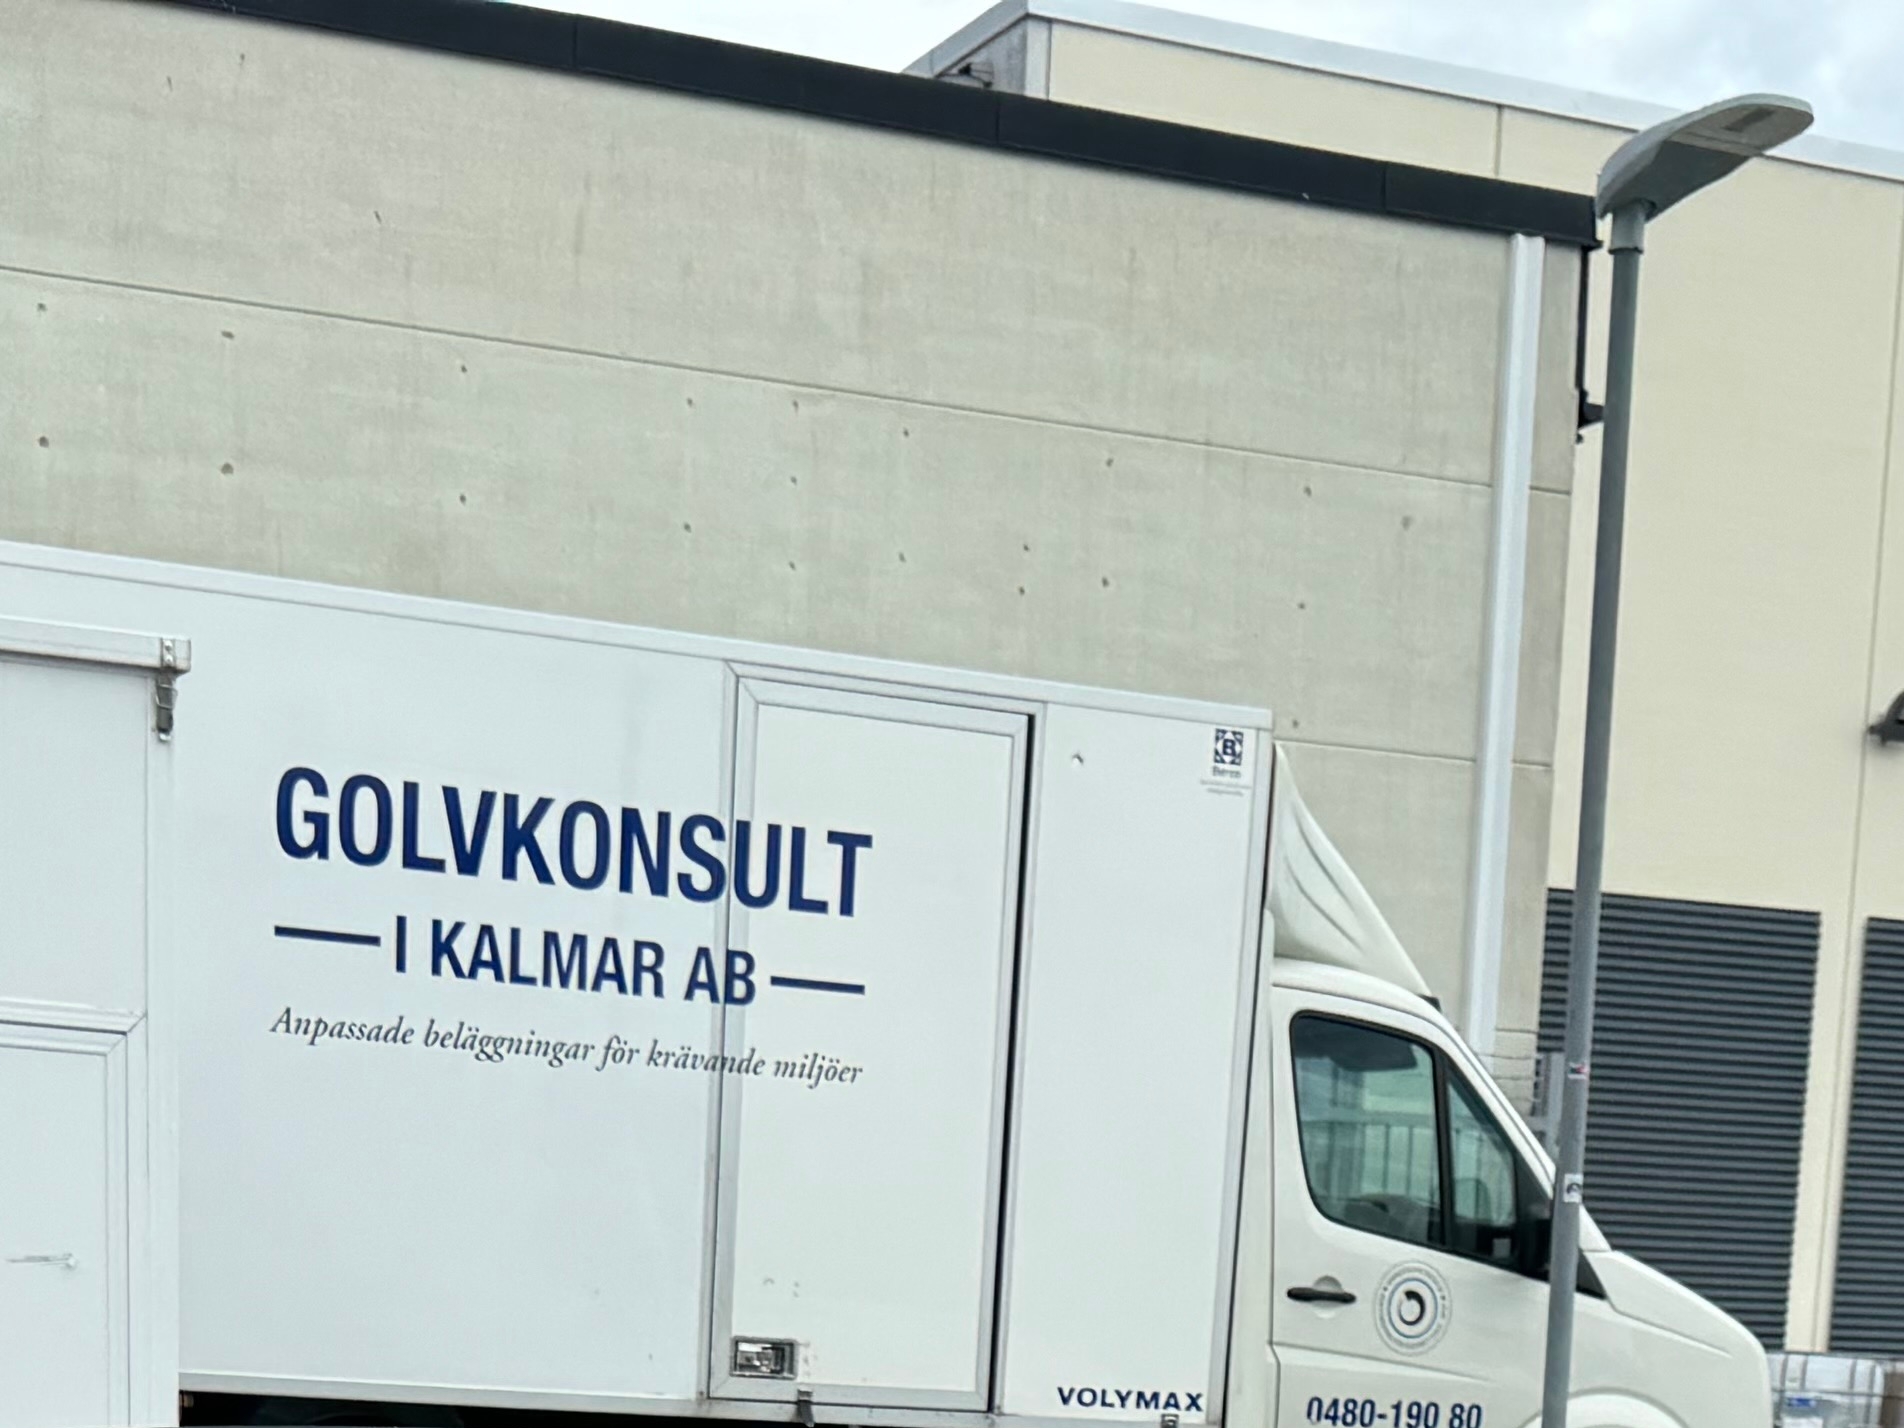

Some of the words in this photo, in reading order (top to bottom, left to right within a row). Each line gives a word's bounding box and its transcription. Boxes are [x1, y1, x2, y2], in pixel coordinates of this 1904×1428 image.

[275, 766, 873, 917] GOLVKONSULT
[395, 915, 407, 973] I
[431, 919, 664, 998] KALMAR
[684, 946, 756, 1006] AB
[269, 1006, 416, 1047] Anpassade
[423, 1017, 596, 1068] beläggningar
[595, 1034, 640, 1072] för
[646, 1039, 766, 1076] krävande
[773, 1052, 864, 1090] miljöer
[1057, 1386, 1204, 1412] VOLYMAX
